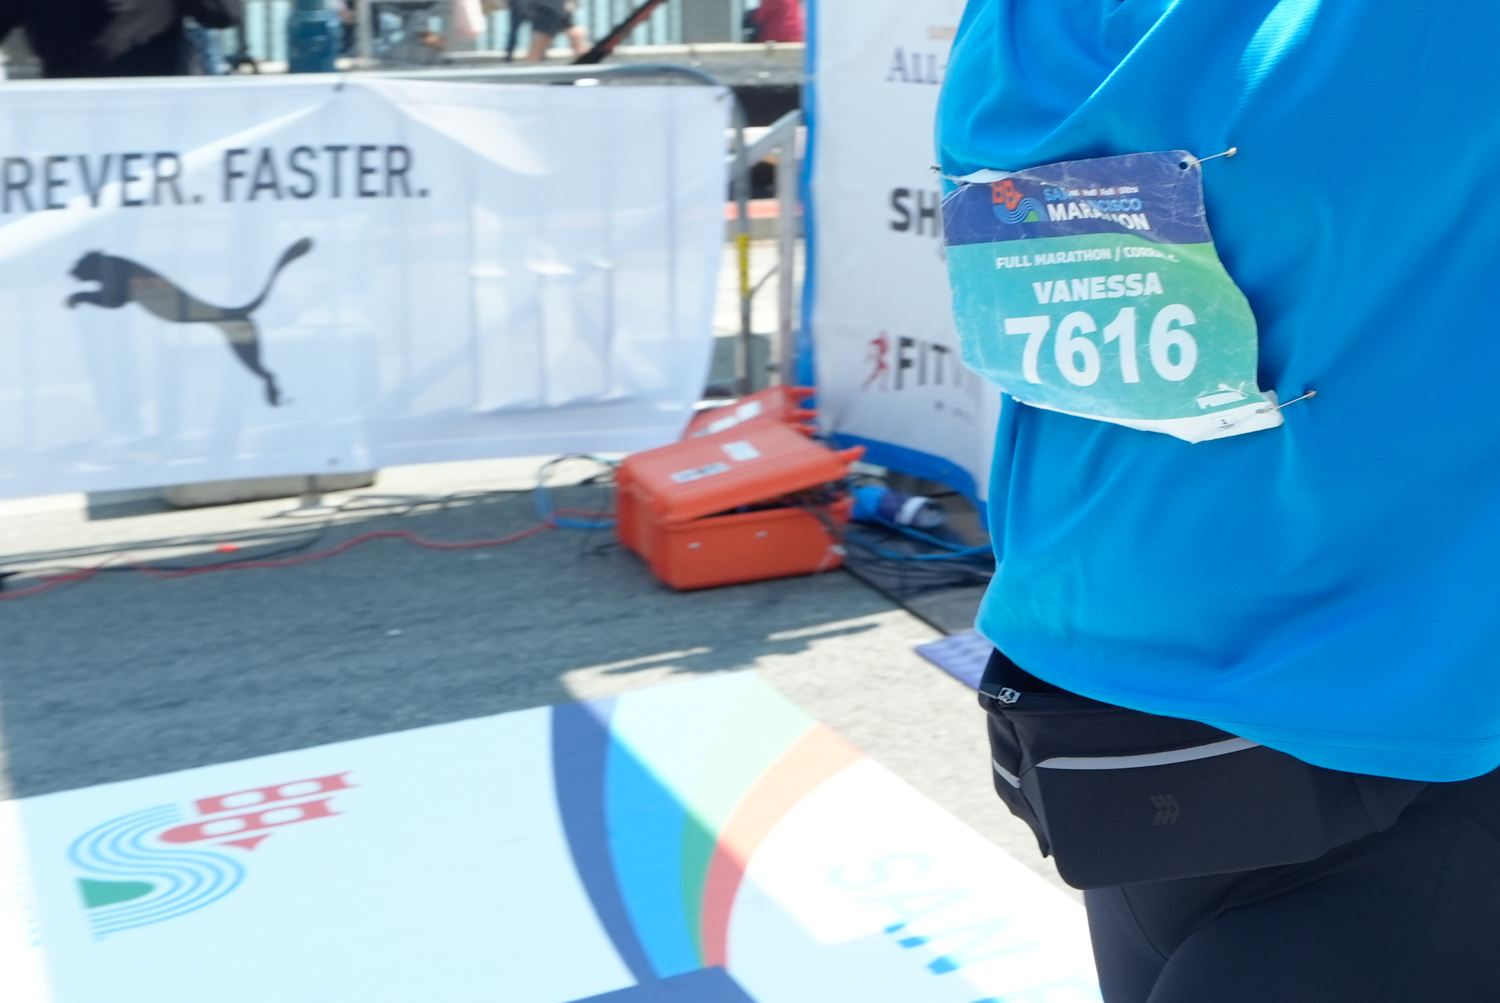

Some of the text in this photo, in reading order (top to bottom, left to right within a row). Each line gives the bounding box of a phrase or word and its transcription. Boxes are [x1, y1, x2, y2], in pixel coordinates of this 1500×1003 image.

[0, 144, 431, 213] REVER. FASTER.
[888, 187, 942, 238] SH
[996, 255, 1032, 269] FULL
[1034, 248, 1112, 267] MARATHON
[1032, 272, 1165, 305] VANESSA
[895, 335, 959, 391] FIT
[1004, 303, 1198, 387] 7616
